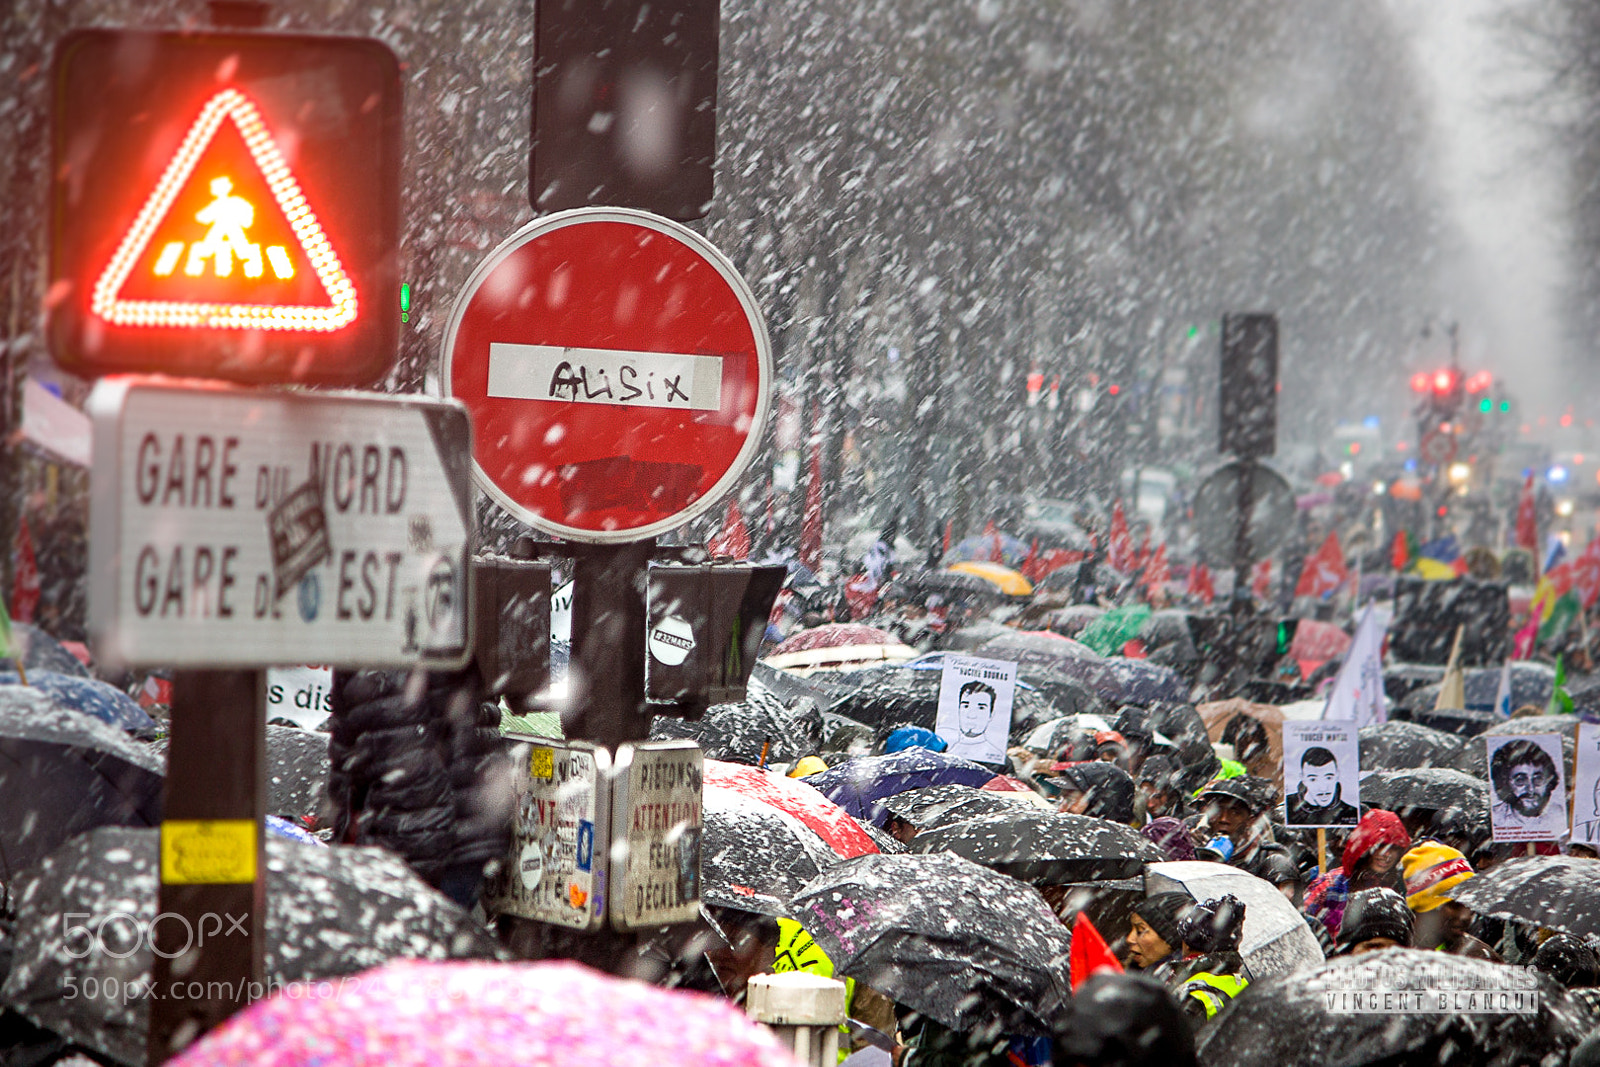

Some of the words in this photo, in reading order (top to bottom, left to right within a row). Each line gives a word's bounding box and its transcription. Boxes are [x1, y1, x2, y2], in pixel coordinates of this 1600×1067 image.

[135, 431, 240, 508] GARE
[309, 440, 408, 515] NORD
[134, 545, 237, 618] GARE
[641, 757, 693, 791] PIÉTONS
[633, 803, 699, 831] ATTENTION
